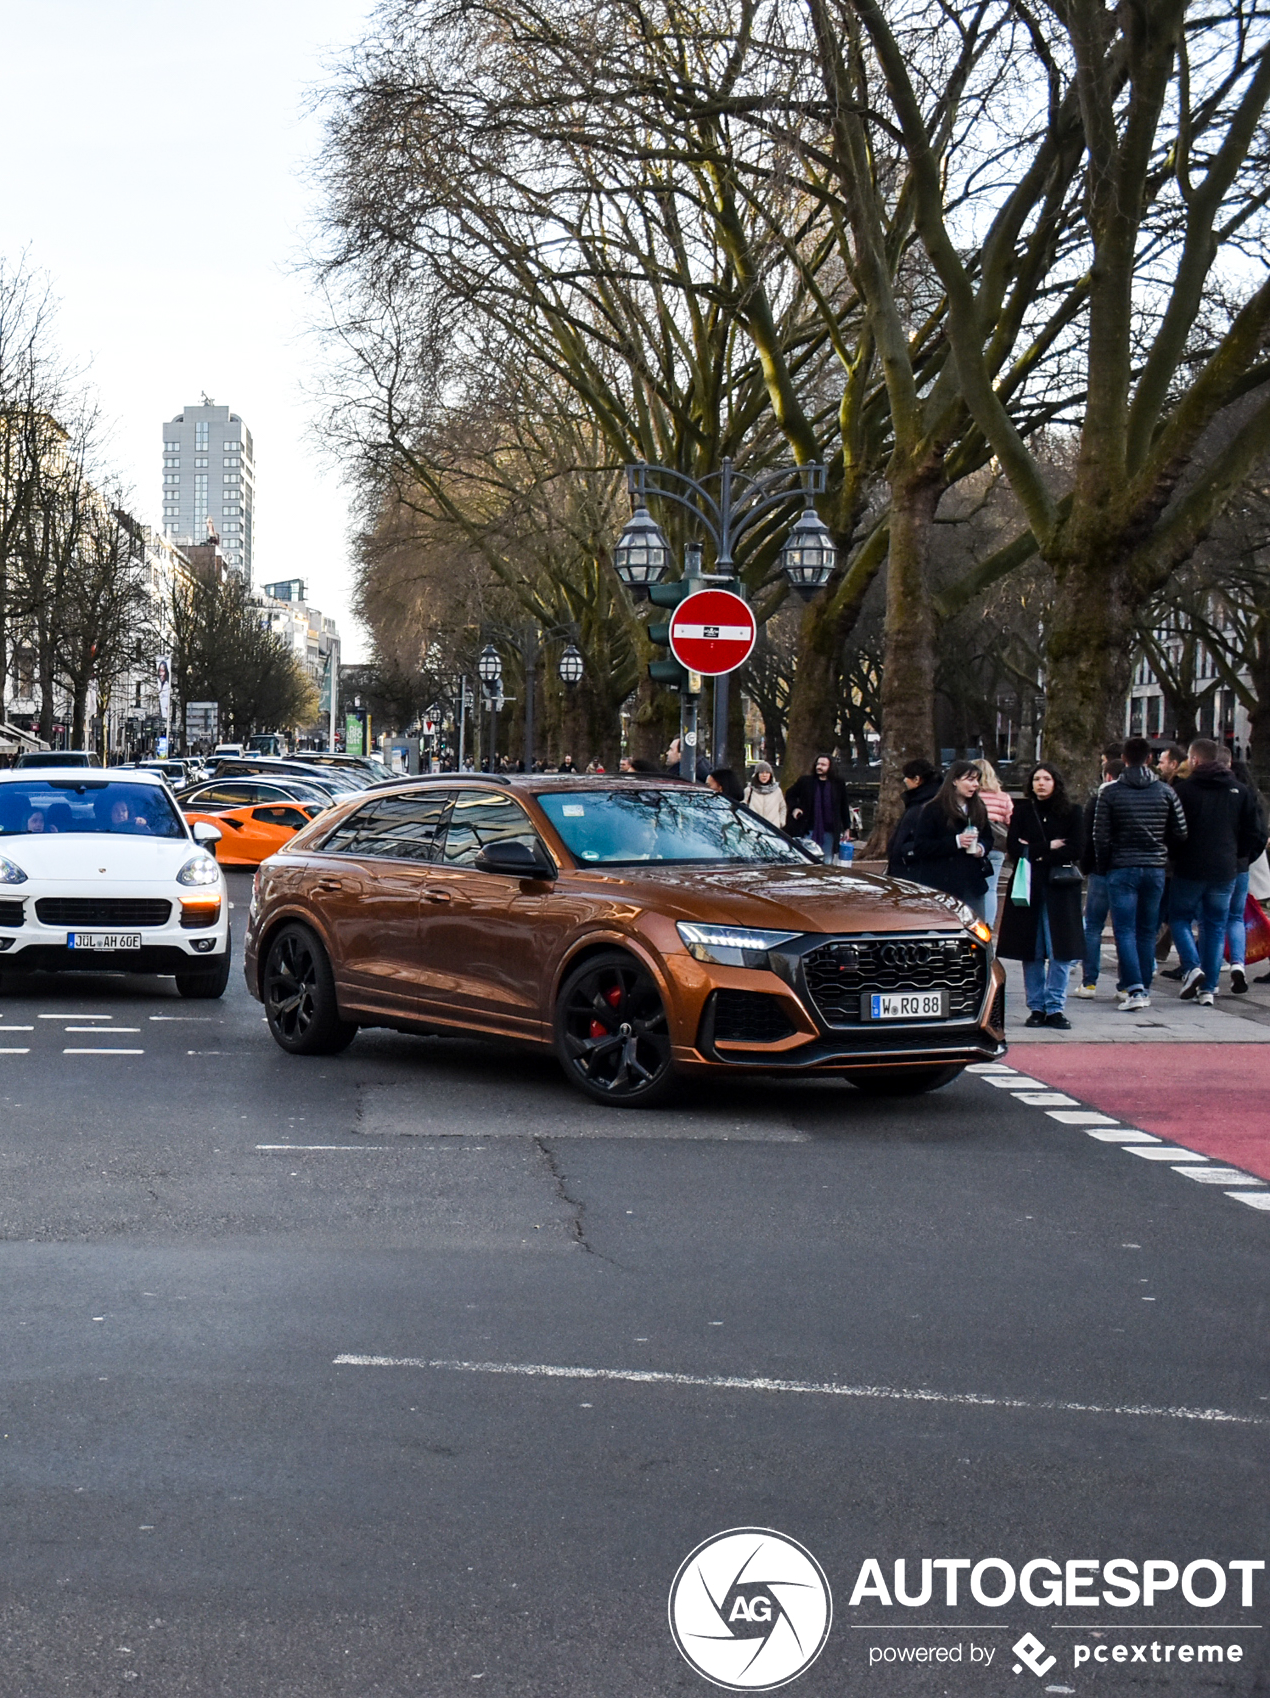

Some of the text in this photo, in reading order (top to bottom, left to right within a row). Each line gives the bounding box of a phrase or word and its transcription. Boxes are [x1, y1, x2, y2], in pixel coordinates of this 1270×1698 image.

[75, 935, 96, 948] JÜL
[103, 935, 118, 948] AH
[119, 935, 139, 948] 60E
[882, 998, 892, 1015] W
[901, 997, 919, 1014] RQ
[923, 996, 939, 1014] 88
